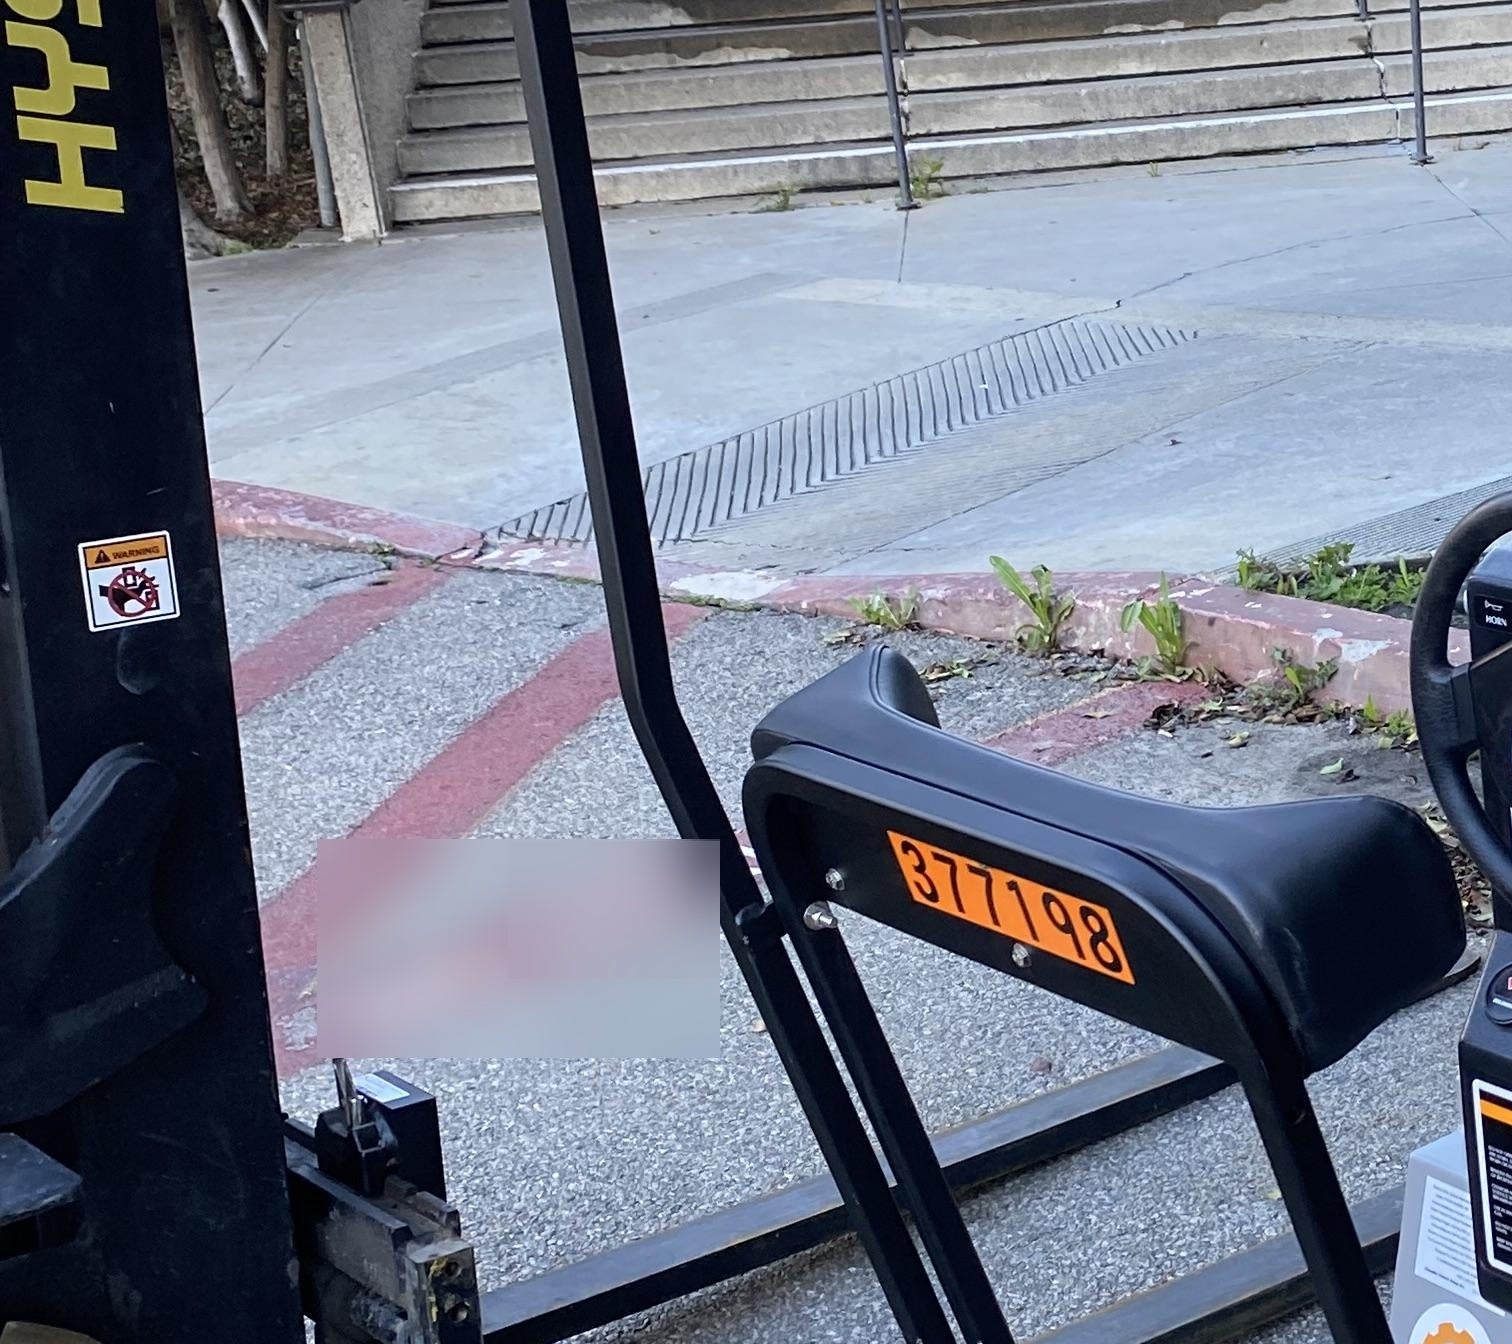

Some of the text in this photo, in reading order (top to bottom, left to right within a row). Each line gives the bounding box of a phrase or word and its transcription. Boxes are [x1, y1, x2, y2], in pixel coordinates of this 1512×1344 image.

[112, 545, 161, 559] WARNING
[1485, 614, 1508, 627] HORN
[900, 840, 1123, 974] 377198
